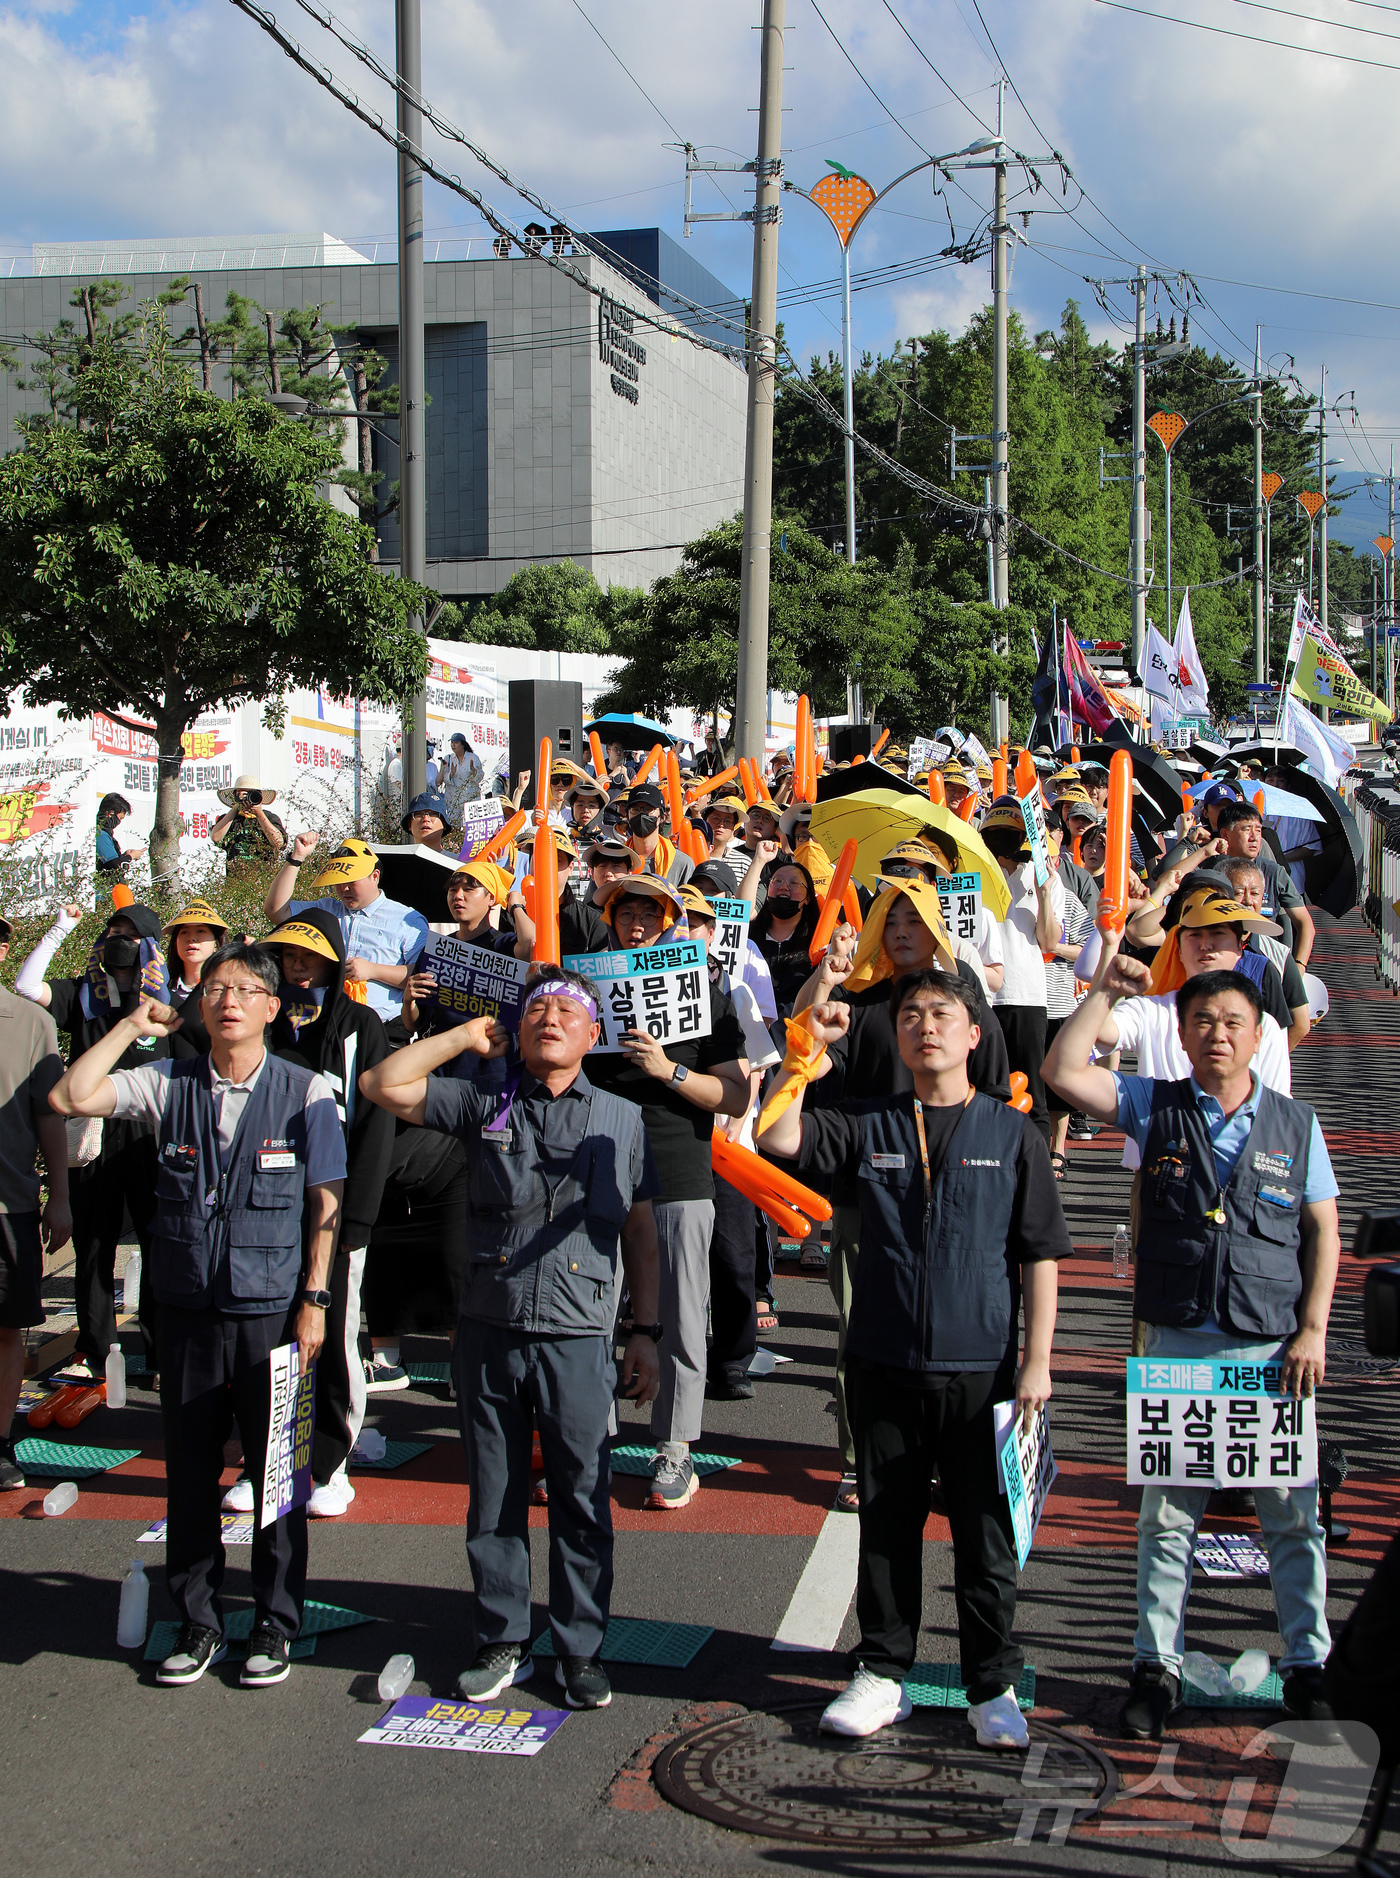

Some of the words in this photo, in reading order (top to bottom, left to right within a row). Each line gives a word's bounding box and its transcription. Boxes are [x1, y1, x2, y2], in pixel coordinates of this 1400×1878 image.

[610, 350, 640, 383] MUSEUM
[1218, 786, 1228, 796] LA
[434, 937, 469, 966] 성과는
[470, 949, 519, 981] 보여줬다
[570, 954, 629, 978] 1조매출
[632, 944, 700, 972] 자랑말고
[425, 957, 471, 992] 공정한
[472, 973, 520, 1006] 분배로
[437, 986, 501, 1020] 증명하라
[1137, 1363, 1215, 1391] 1조매출
[1219, 1366, 1305, 1393] 자랑말
[295, 1367, 314, 1472] 증명하라
[383, 1715, 464, 1736] 분배로
[426, 1702, 533, 1727] 증명하라
[463, 1722, 547, 1742] 공정한
